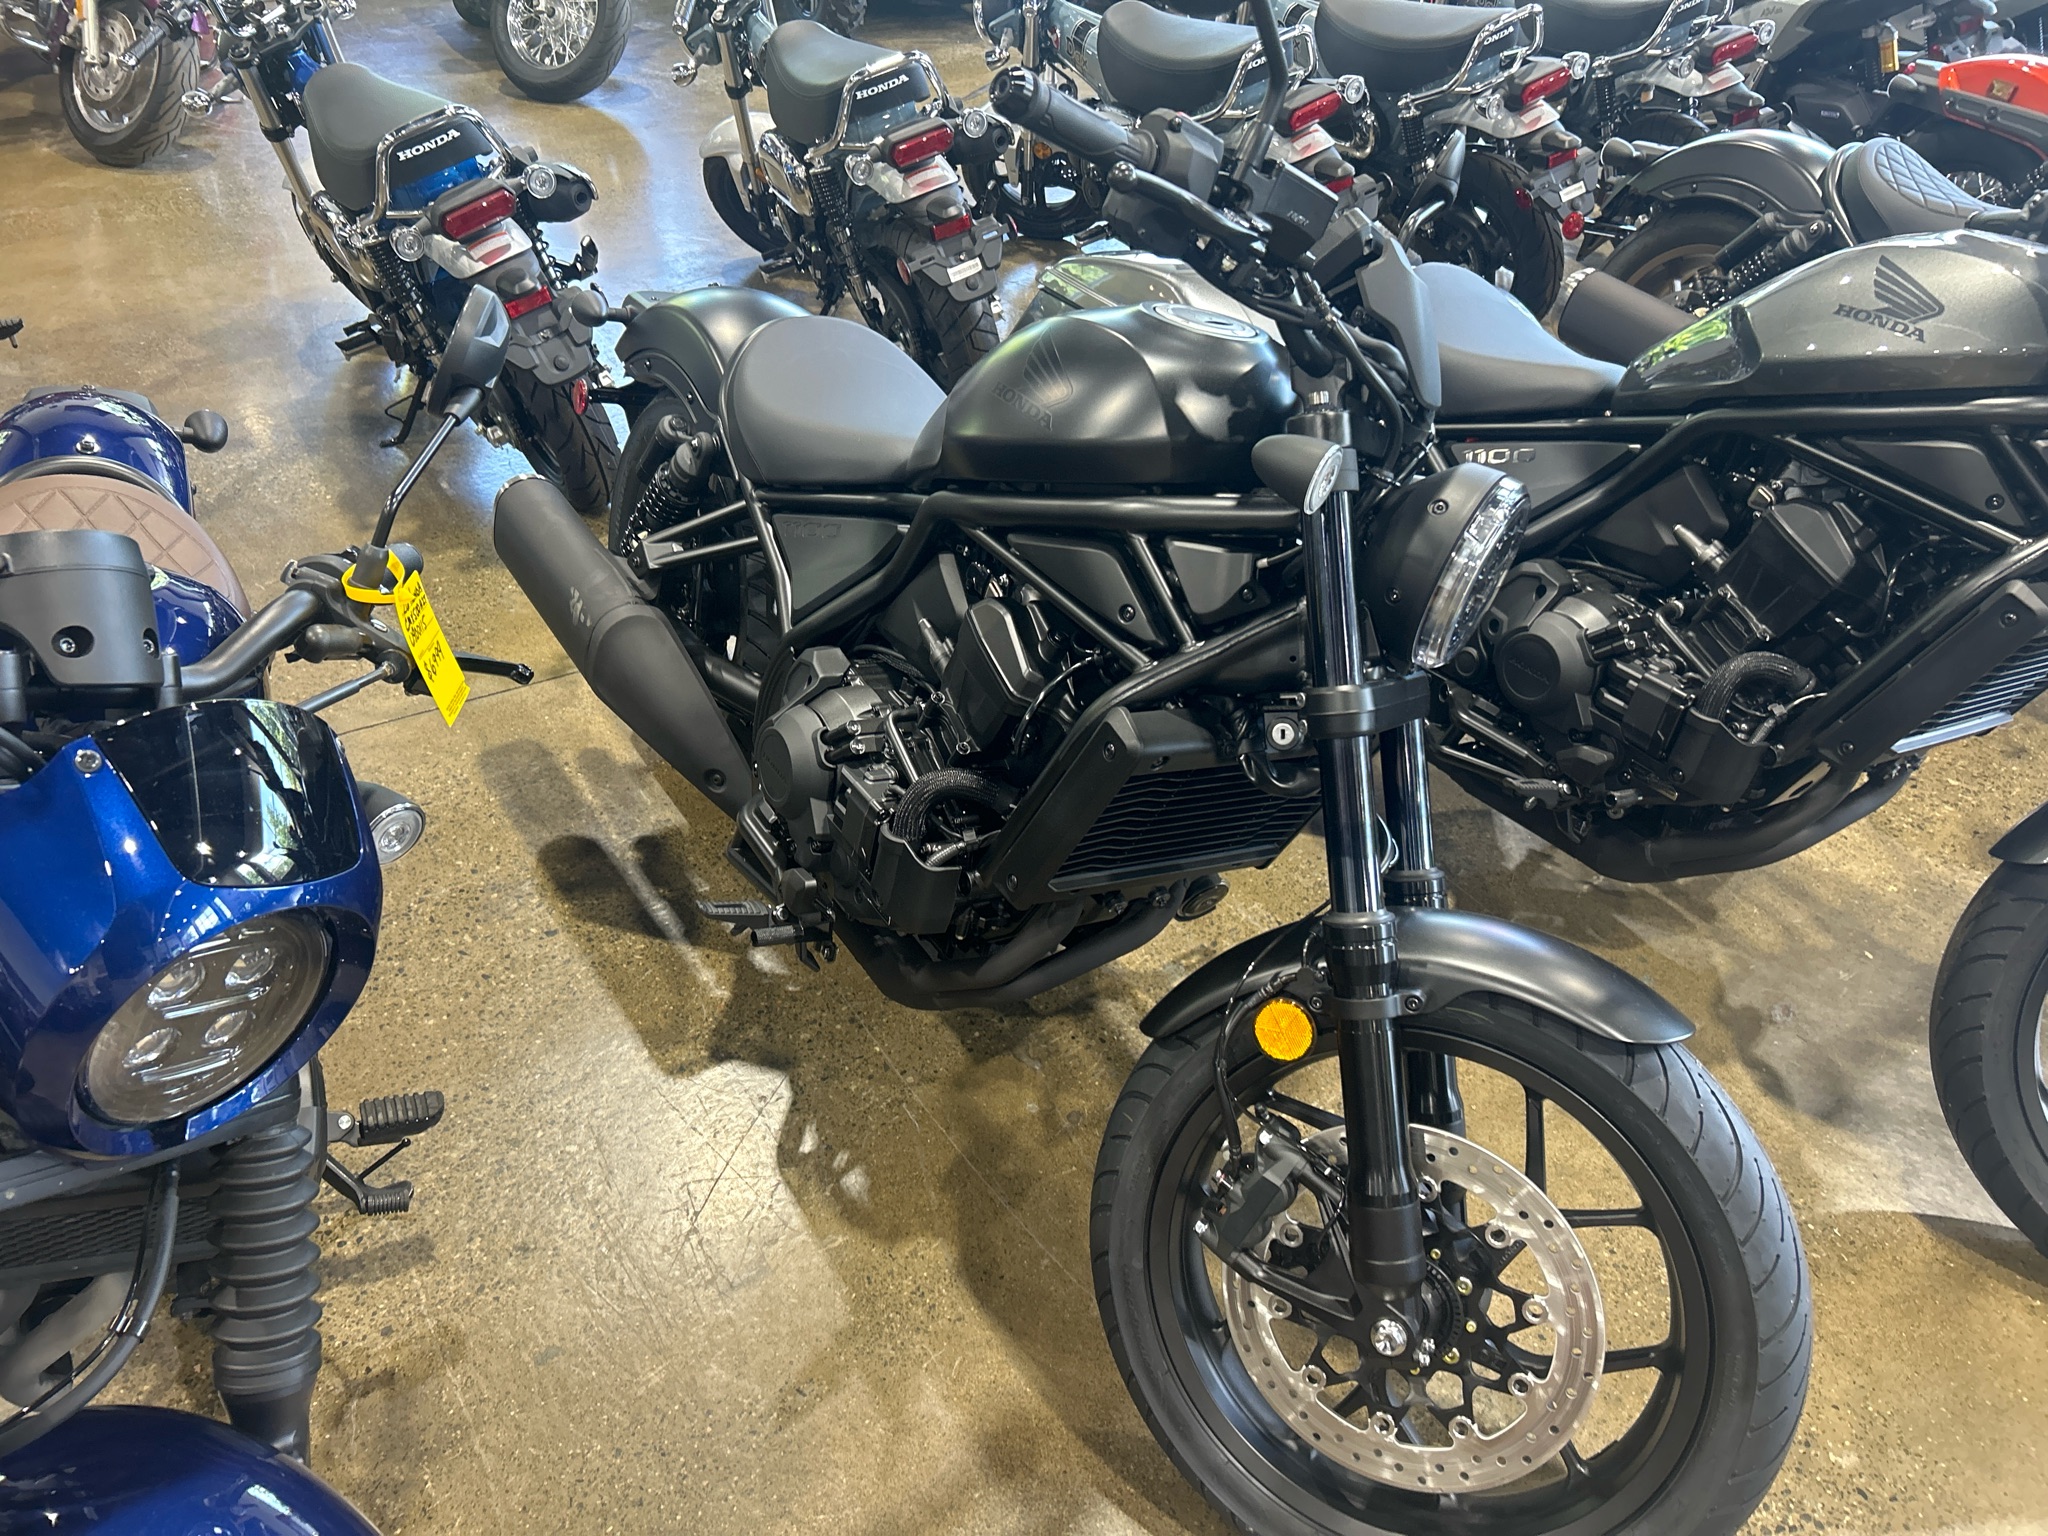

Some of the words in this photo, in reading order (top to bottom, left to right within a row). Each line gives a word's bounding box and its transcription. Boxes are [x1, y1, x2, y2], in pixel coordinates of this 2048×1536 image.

[1483, 25, 1515, 46] ONDA
[855, 74, 909, 100] HONDA
[396, 128, 461, 161] HONDA
[1832, 303, 1926, 344] HONDA
[992, 381, 1053, 432] HONDA
[1462, 448, 1536, 464] 1100
[423, 639, 445, 683] $6999
